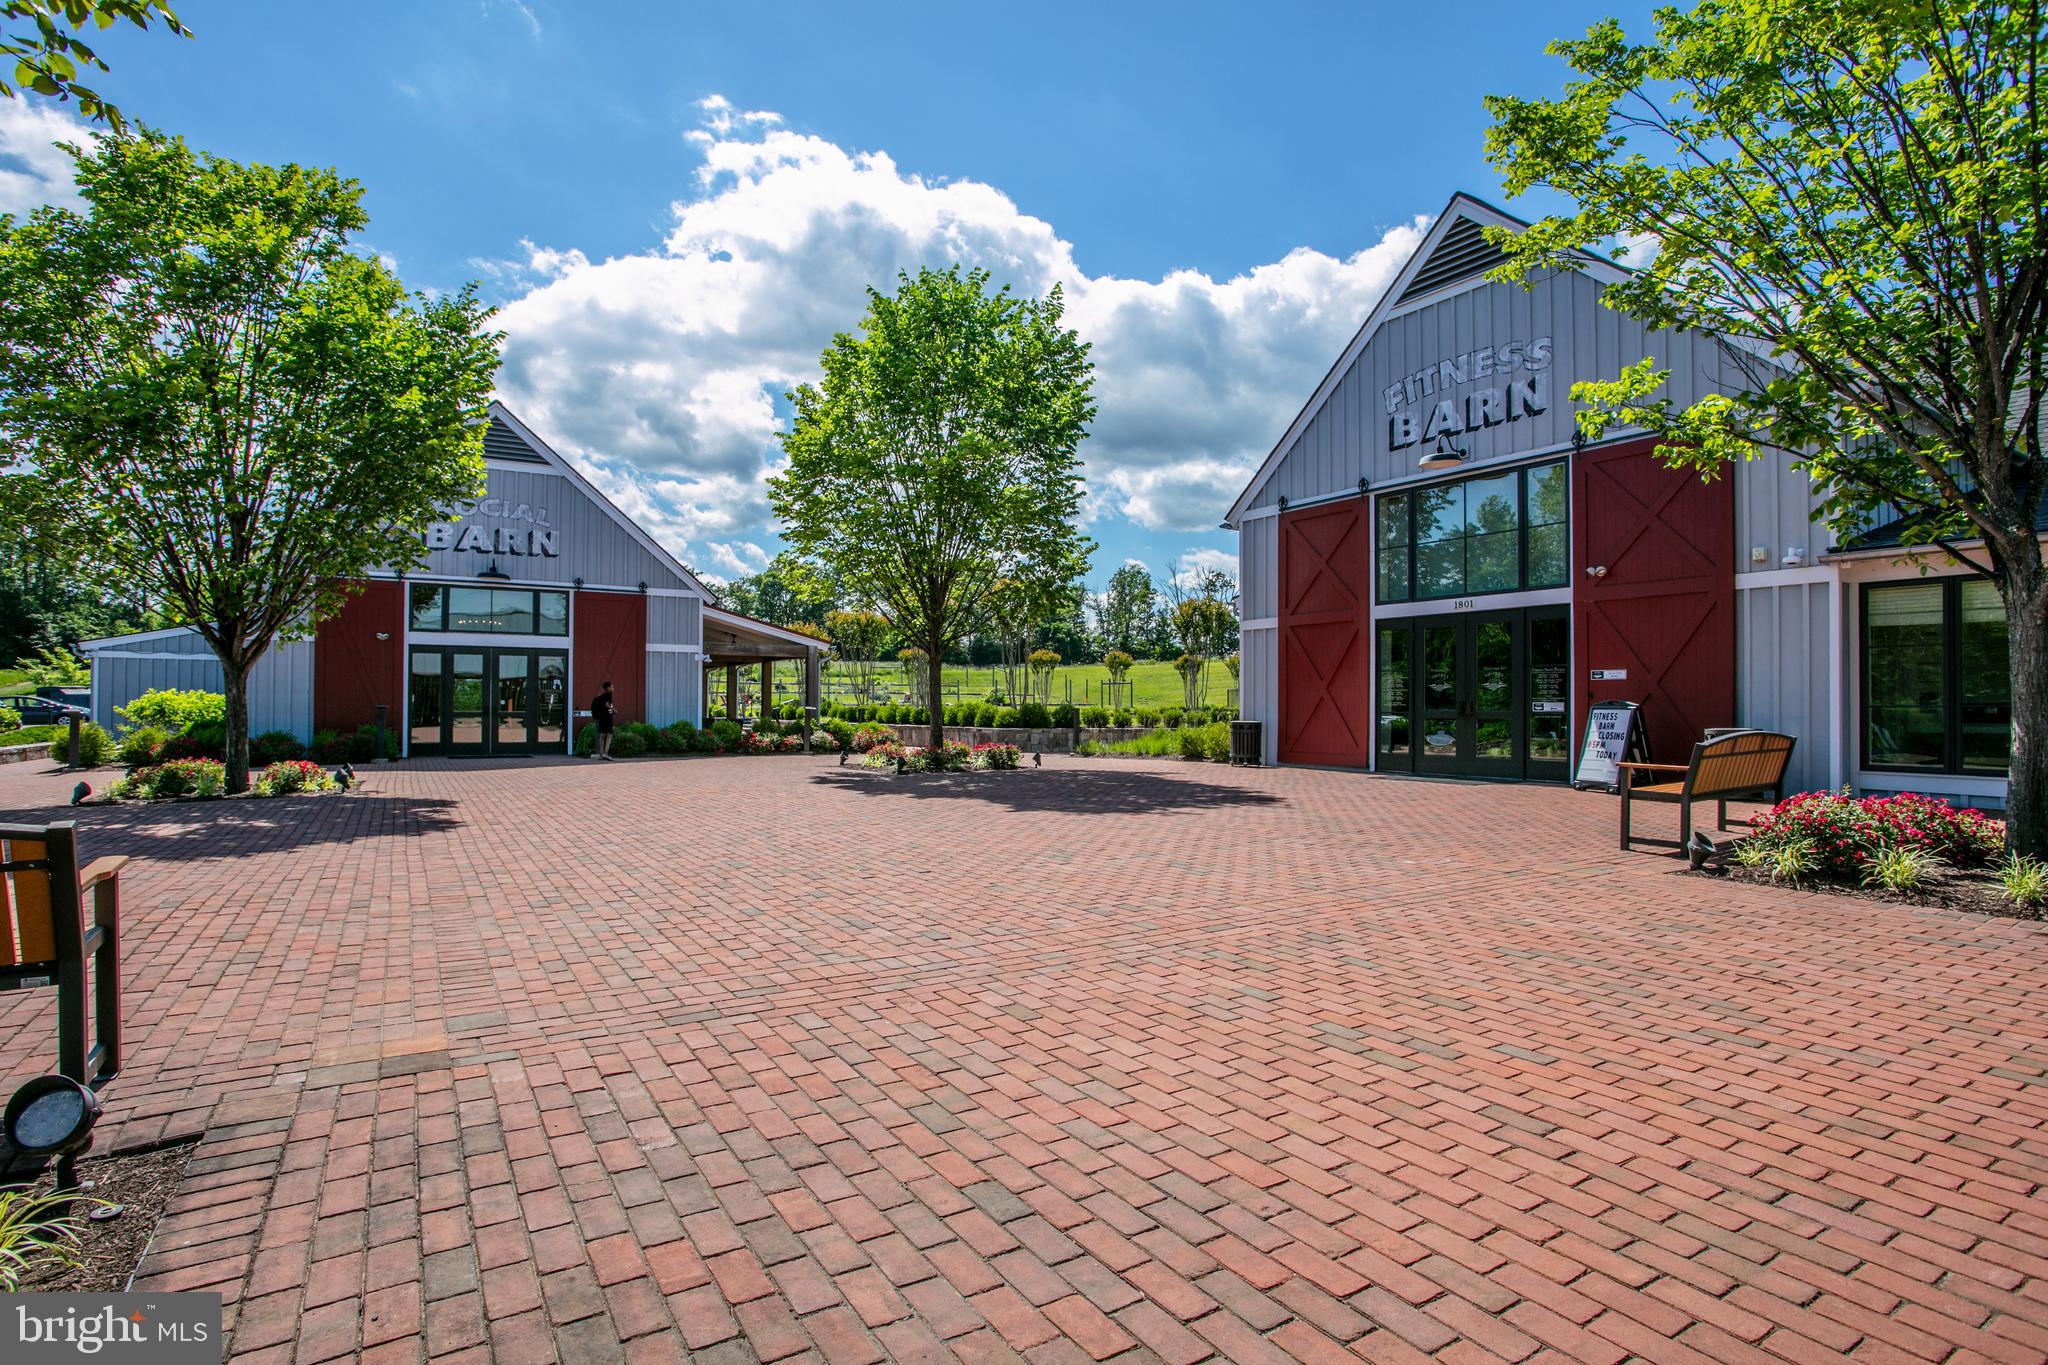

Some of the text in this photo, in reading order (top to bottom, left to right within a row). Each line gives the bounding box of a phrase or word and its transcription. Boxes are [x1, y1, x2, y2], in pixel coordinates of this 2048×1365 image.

[1383, 337, 1552, 415] FITNESS
[1389, 373, 1549, 451] BARN
[422, 522, 560, 558] BARN
[1454, 600, 1473, 609] 1801
[1593, 712, 1618, 721] FITNESS
[1599, 721, 1616, 730] BARN
[1598, 731, 1625, 741] CLOSING
[1596, 750, 1618, 760] TODAY
